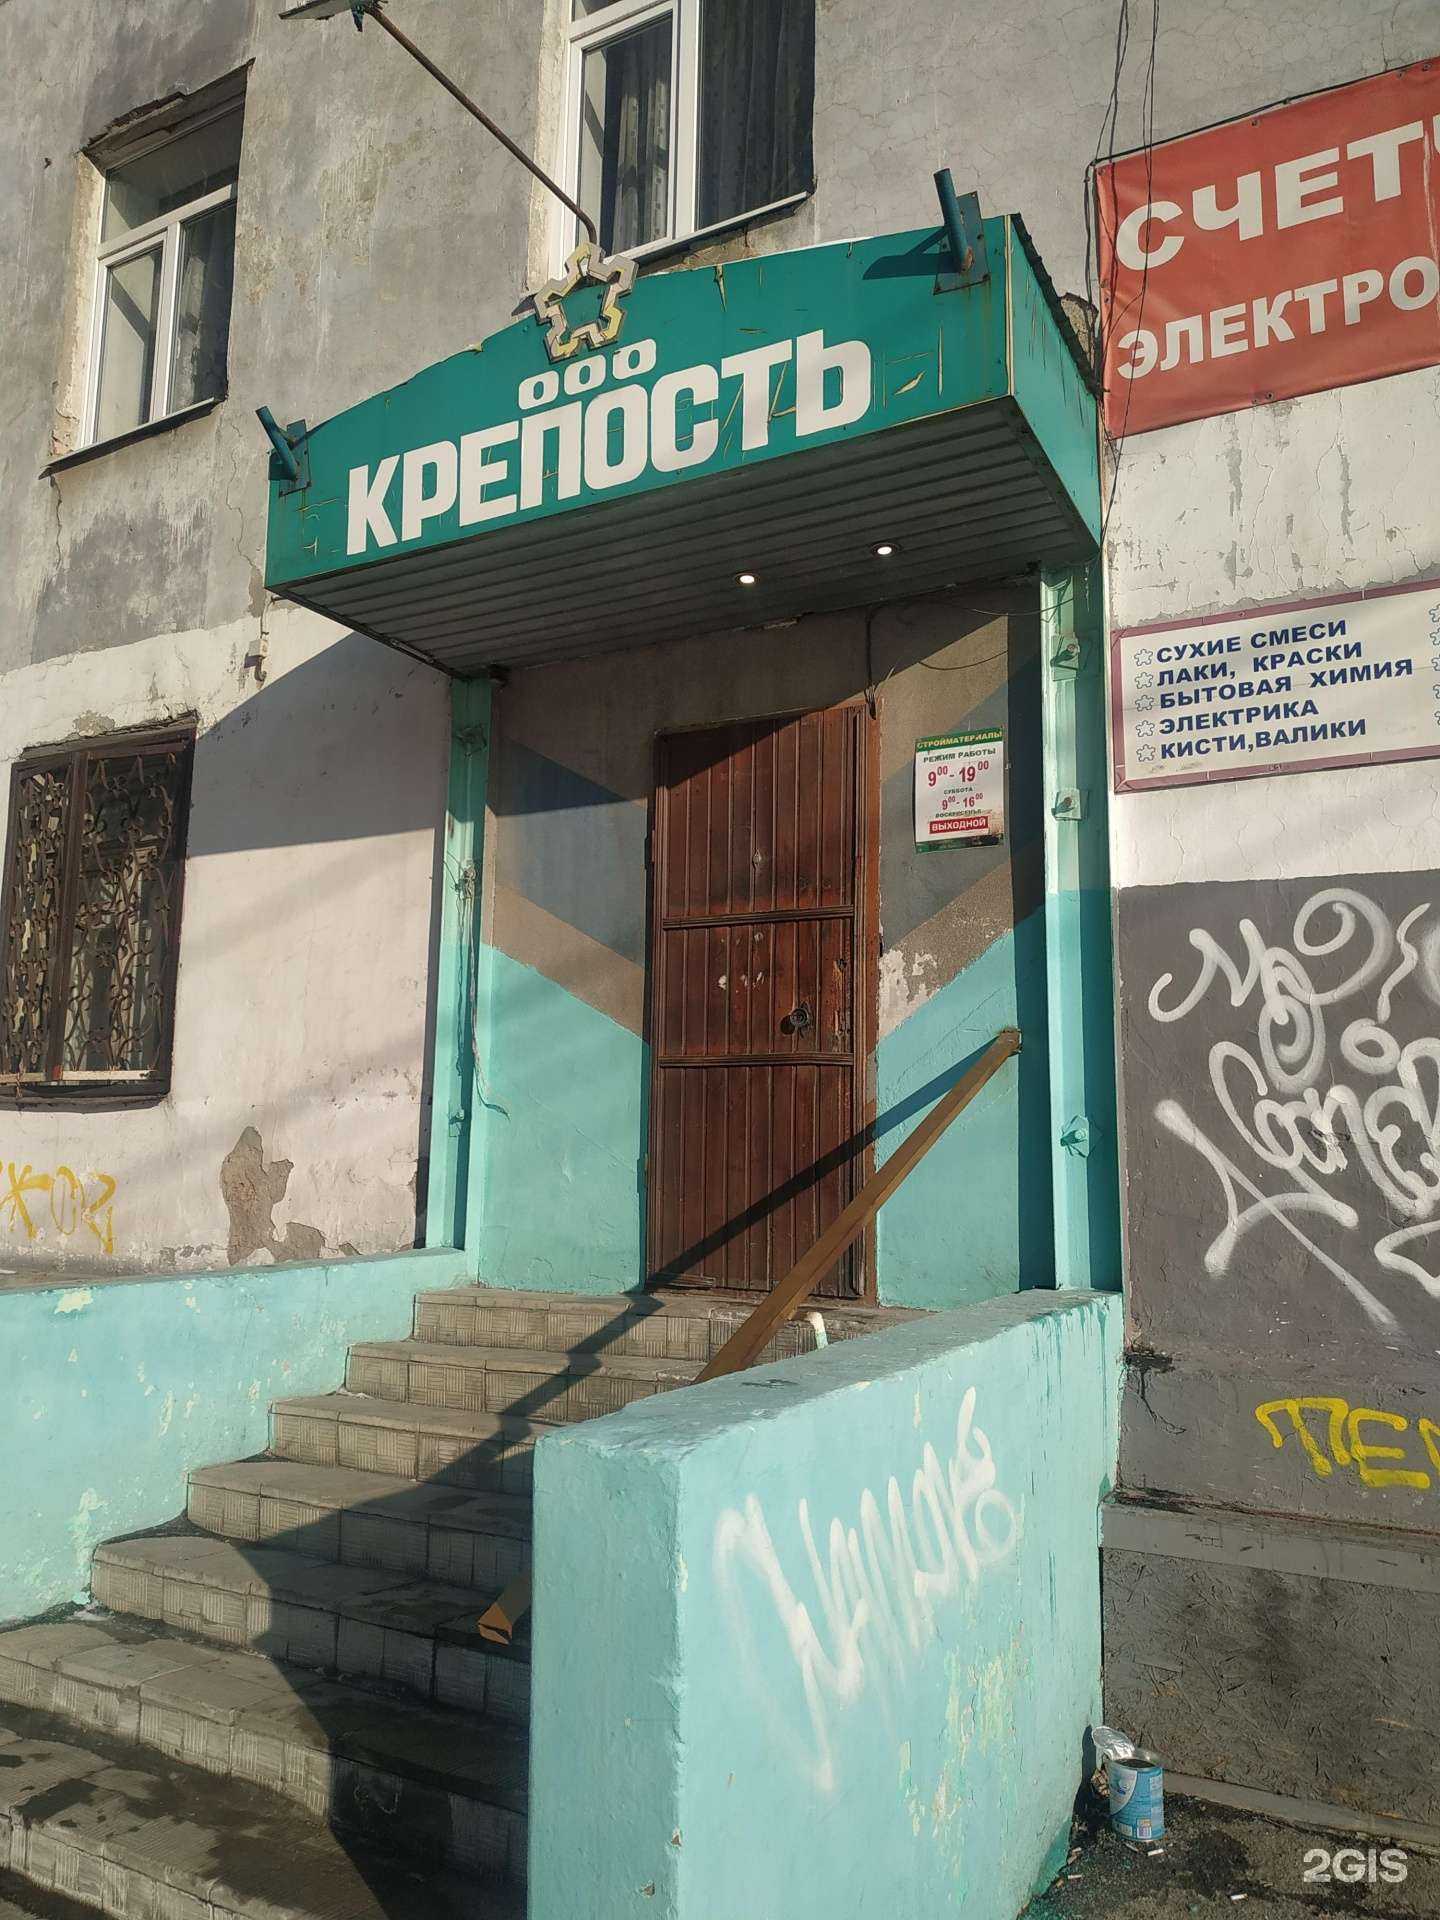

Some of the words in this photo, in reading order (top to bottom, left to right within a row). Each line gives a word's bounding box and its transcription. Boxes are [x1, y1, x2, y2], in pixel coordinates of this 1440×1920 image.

[1117, 256, 1440, 380] ЭЛЕКТРО
[518, 338, 657, 410] ООО
[346, 328, 872, 555] КРЕПОСТЬ
[1156, 636, 1242, 663] СУХИЕ
[1250, 619, 1347, 649] СМЕСИ
[1157, 661, 1237, 687] ЛАКИ,
[1253, 642, 1363, 673] КРАСКИ
[1160, 676, 1292, 709] БЫТОВАЯ
[1309, 658, 1413, 688] ХИМИЯ
[1158, 698, 1320, 735] ЭЛЕКТРИКА
[916, 731, 1003, 749] СТРОЙМАТЕРИАЛЫ
[923, 753, 956, 763] РЕЖИМ
[958, 748, 996, 759] РАБОТЫ
[931, 817, 986, 832] ВЫХОДНОЙ
